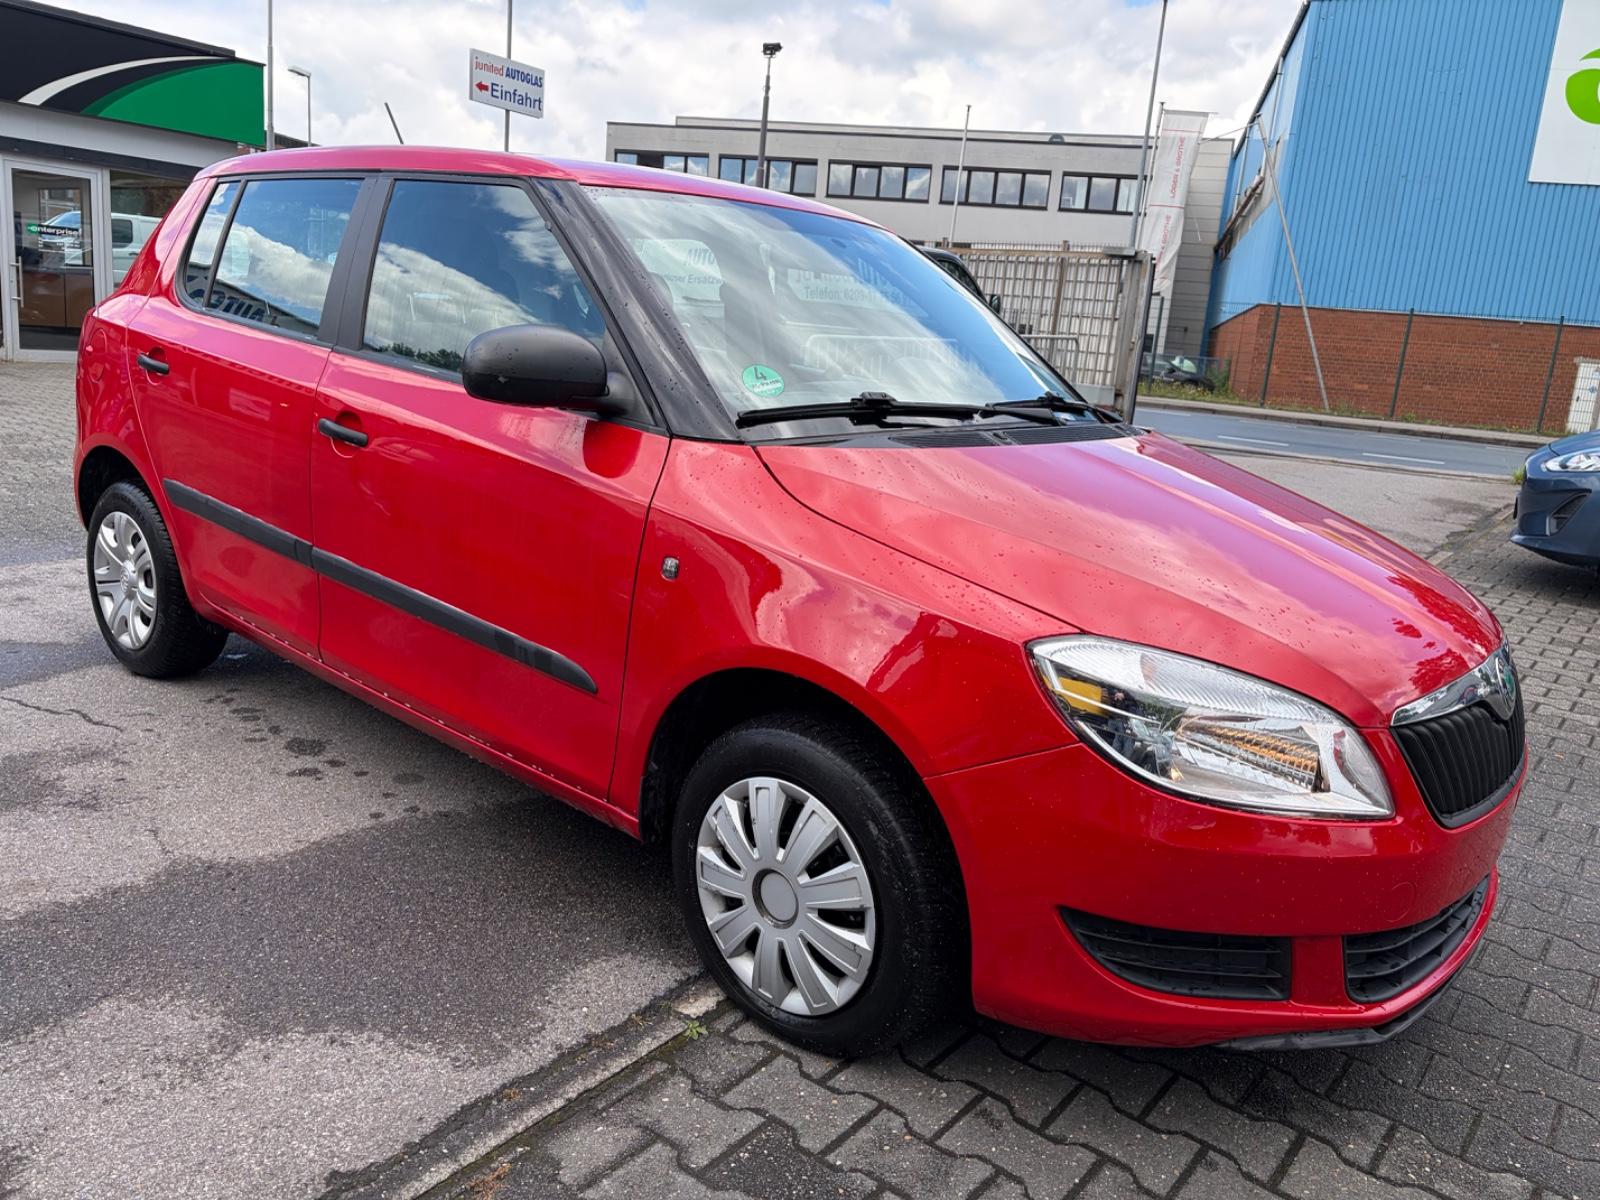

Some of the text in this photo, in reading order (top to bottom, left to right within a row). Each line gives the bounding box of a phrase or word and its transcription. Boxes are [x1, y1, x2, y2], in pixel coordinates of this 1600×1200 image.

[475, 56, 543, 88] junited AUTOGLAS
[491, 82, 542, 111] Einfahrt
[754, 366, 767, 380] 4
